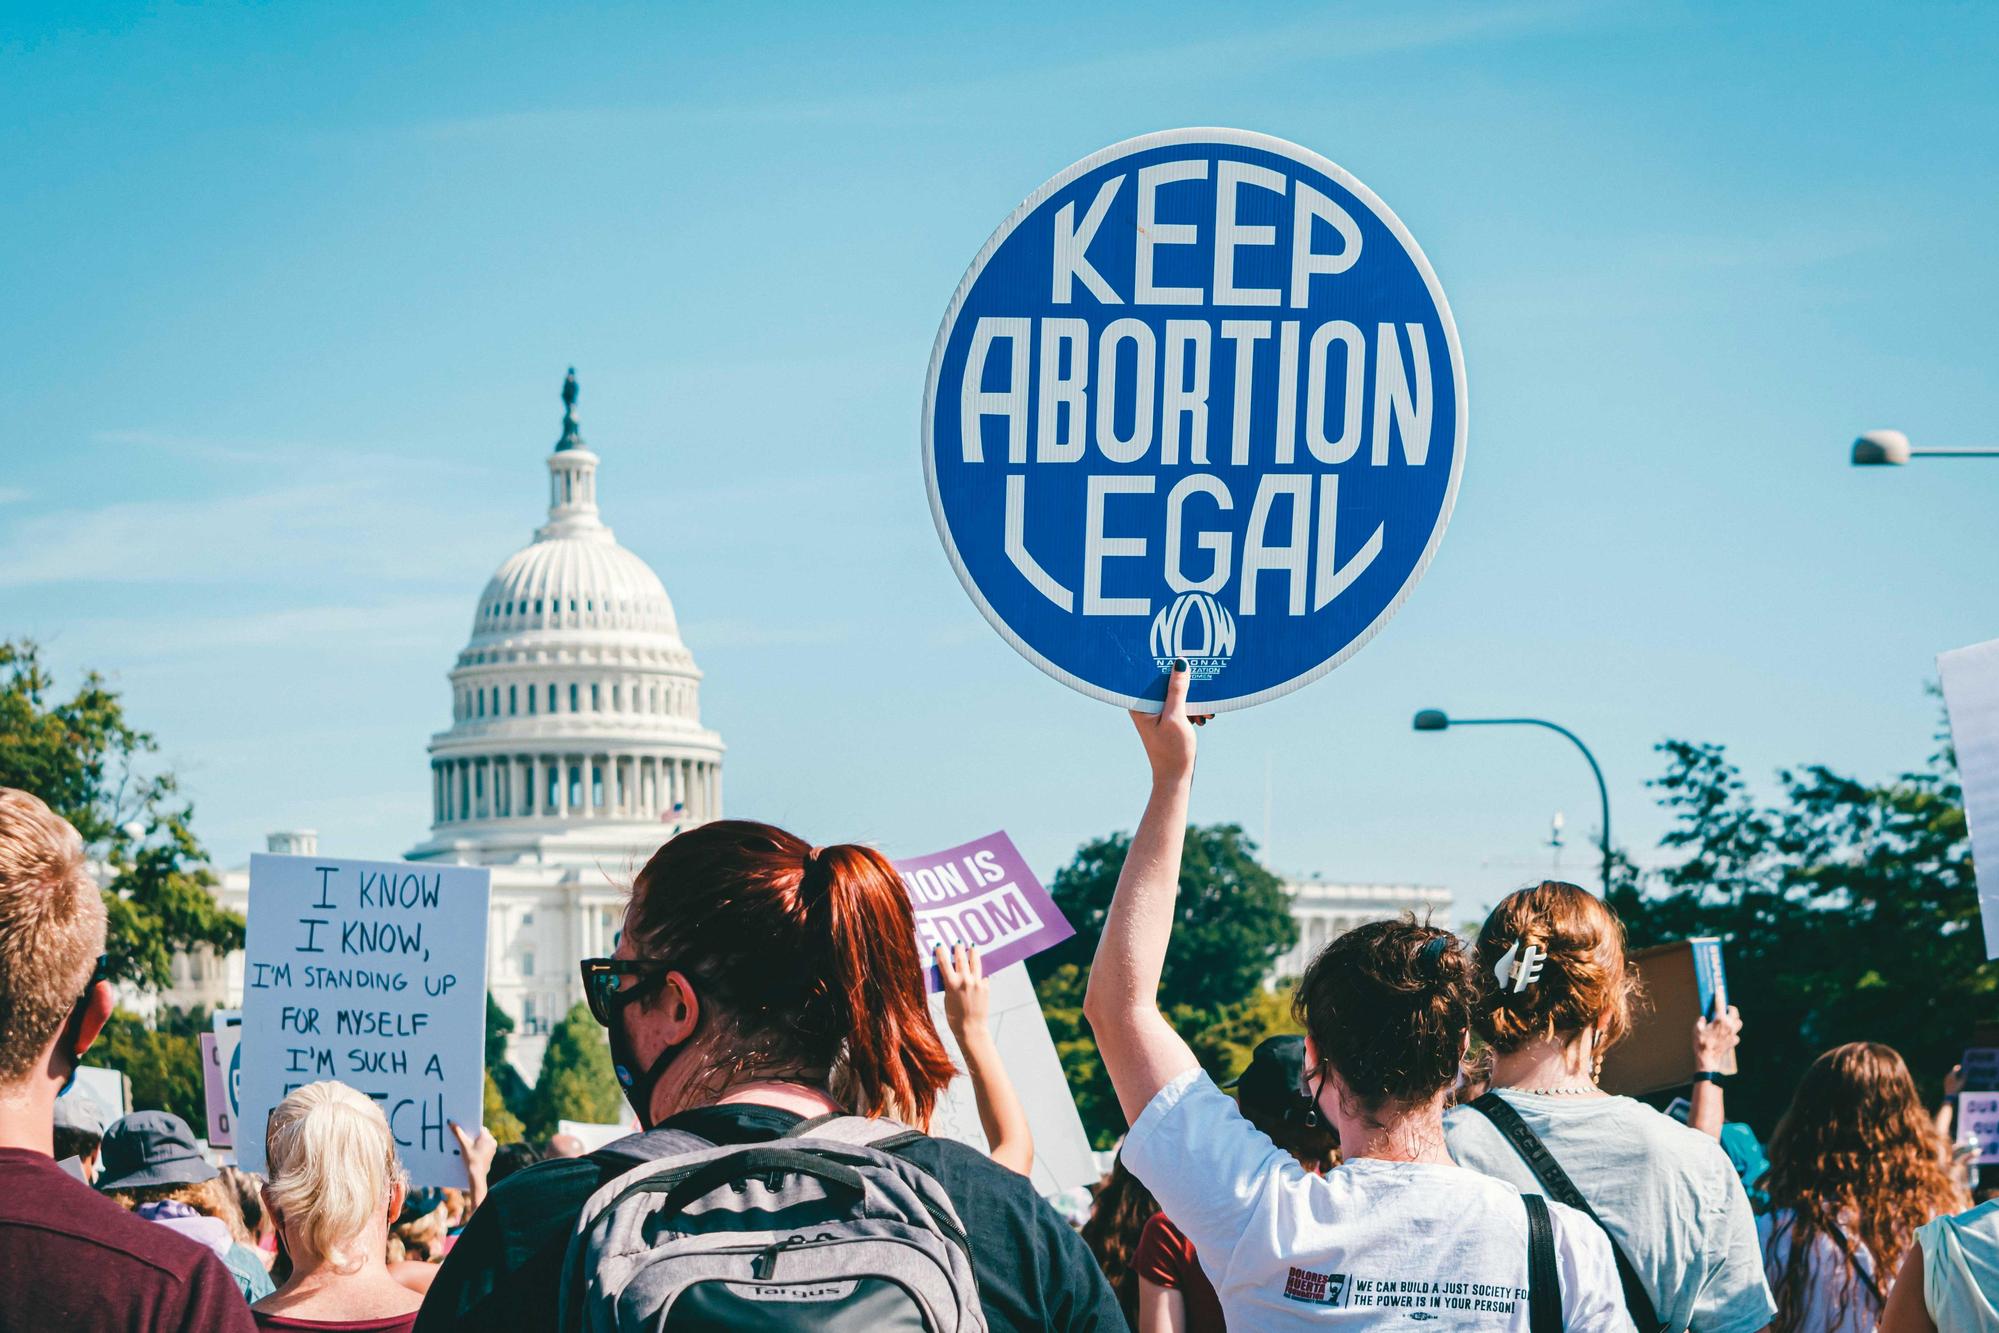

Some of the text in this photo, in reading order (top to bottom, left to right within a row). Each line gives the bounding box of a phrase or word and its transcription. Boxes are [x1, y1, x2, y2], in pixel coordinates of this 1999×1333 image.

[1052, 159, 1363, 309] KEEP
[961, 317, 1433, 466] ABORTION
[1005, 473, 1384, 616] LEGAL
[1150, 594, 1236, 656] NOW
[312, 866, 441, 909] I KNOW
[900, 850, 1005, 904] ION IS
[296, 918, 429, 962] I KNOW,
[917, 891, 1032, 957] EDOM
[251, 962, 456, 997] I'M STANDING UP
[281, 1007, 429, 1037] FOR MYSELF
[285, 1046, 444, 1081] I'M SUCH A
[749, 1287, 840, 1298] Targus
[1287, 1276, 1326, 1293] HUERTA
[1290, 1267, 1328, 1284] DOLORES
[1356, 1280, 1528, 1300] WE CAN BUILD A JUST SOCIETY FO
[1355, 1295, 1515, 1314] THE POWER IS IN YOUR PERSON!
